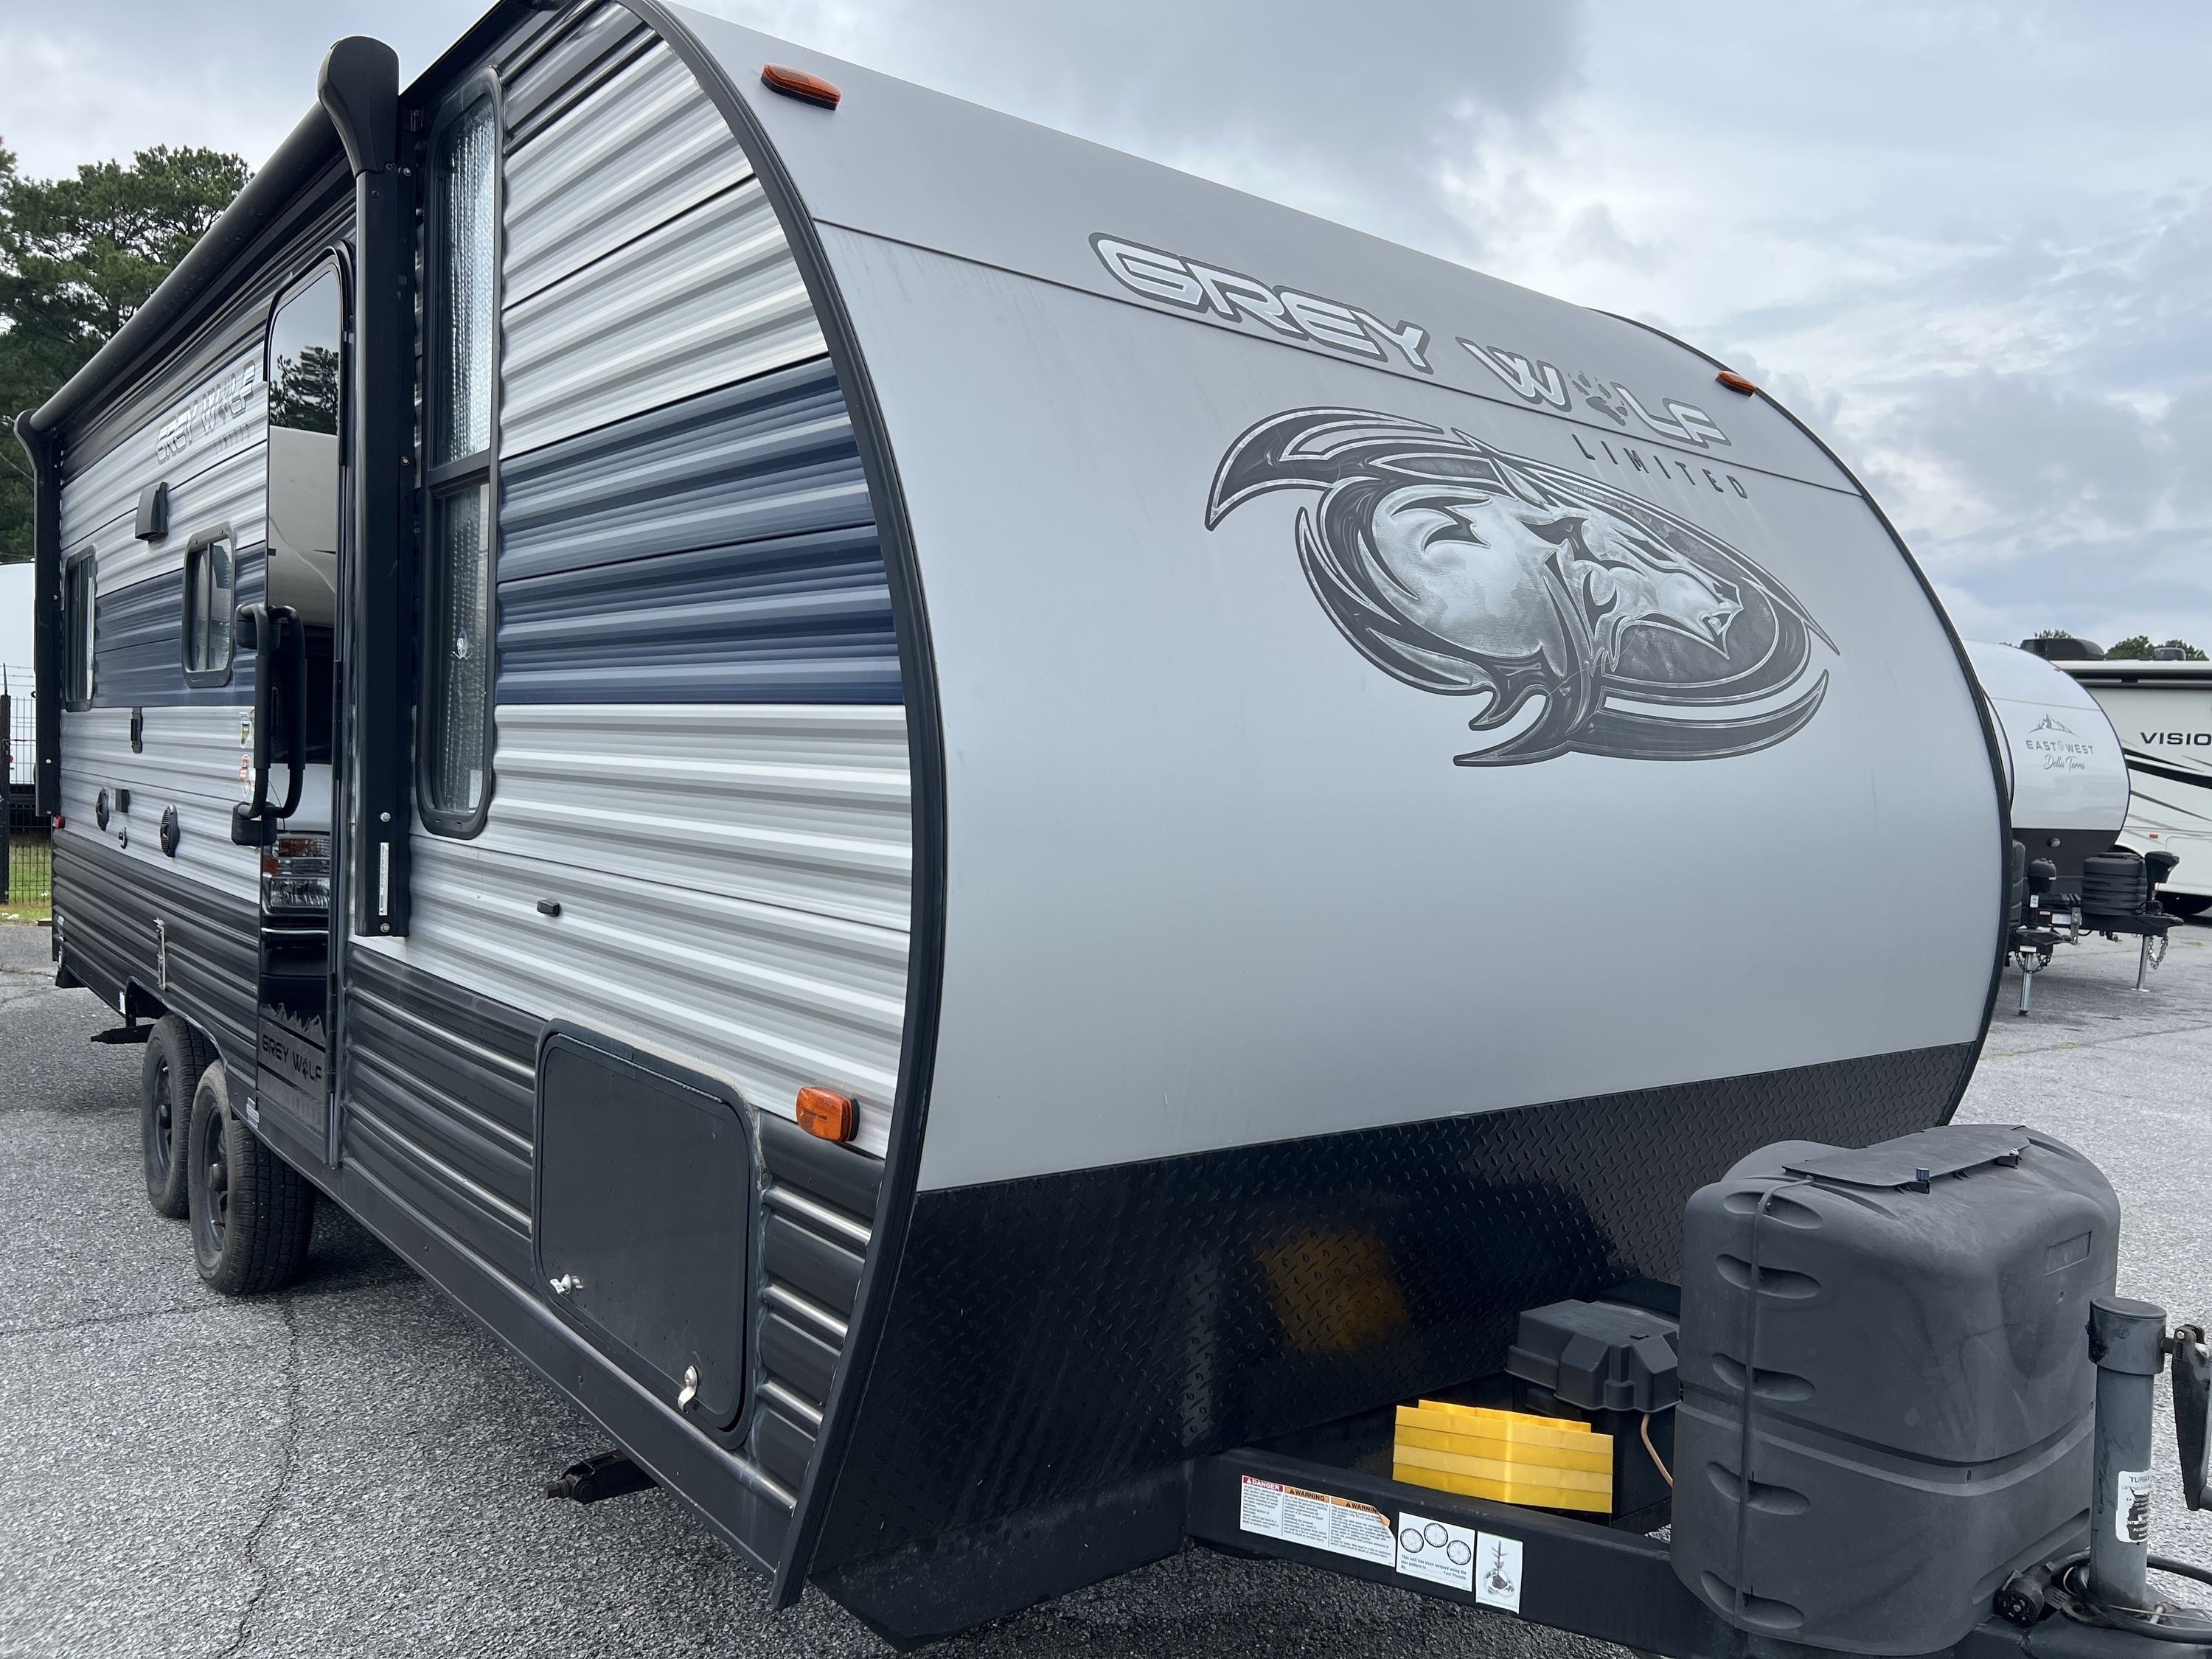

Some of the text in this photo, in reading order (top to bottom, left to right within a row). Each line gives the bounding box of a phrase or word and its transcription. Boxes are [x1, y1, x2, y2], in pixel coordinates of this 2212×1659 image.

[1088, 232, 1434, 375] GREY
[155, 399, 198, 465] GREY
[1571, 434, 1748, 499] LIMITED
[2140, 731, 2212, 745] VISIO
[2025, 740, 2093, 755] EAST WEST
[2043, 754, 2085, 772] Della Terra
[262, 1034, 289, 1063] GREY
[1252, 1479, 1280, 1491] DANGER
[1295, 1489, 1325, 1501] WARNING
[1352, 1503, 1377, 1514] WARNIN
